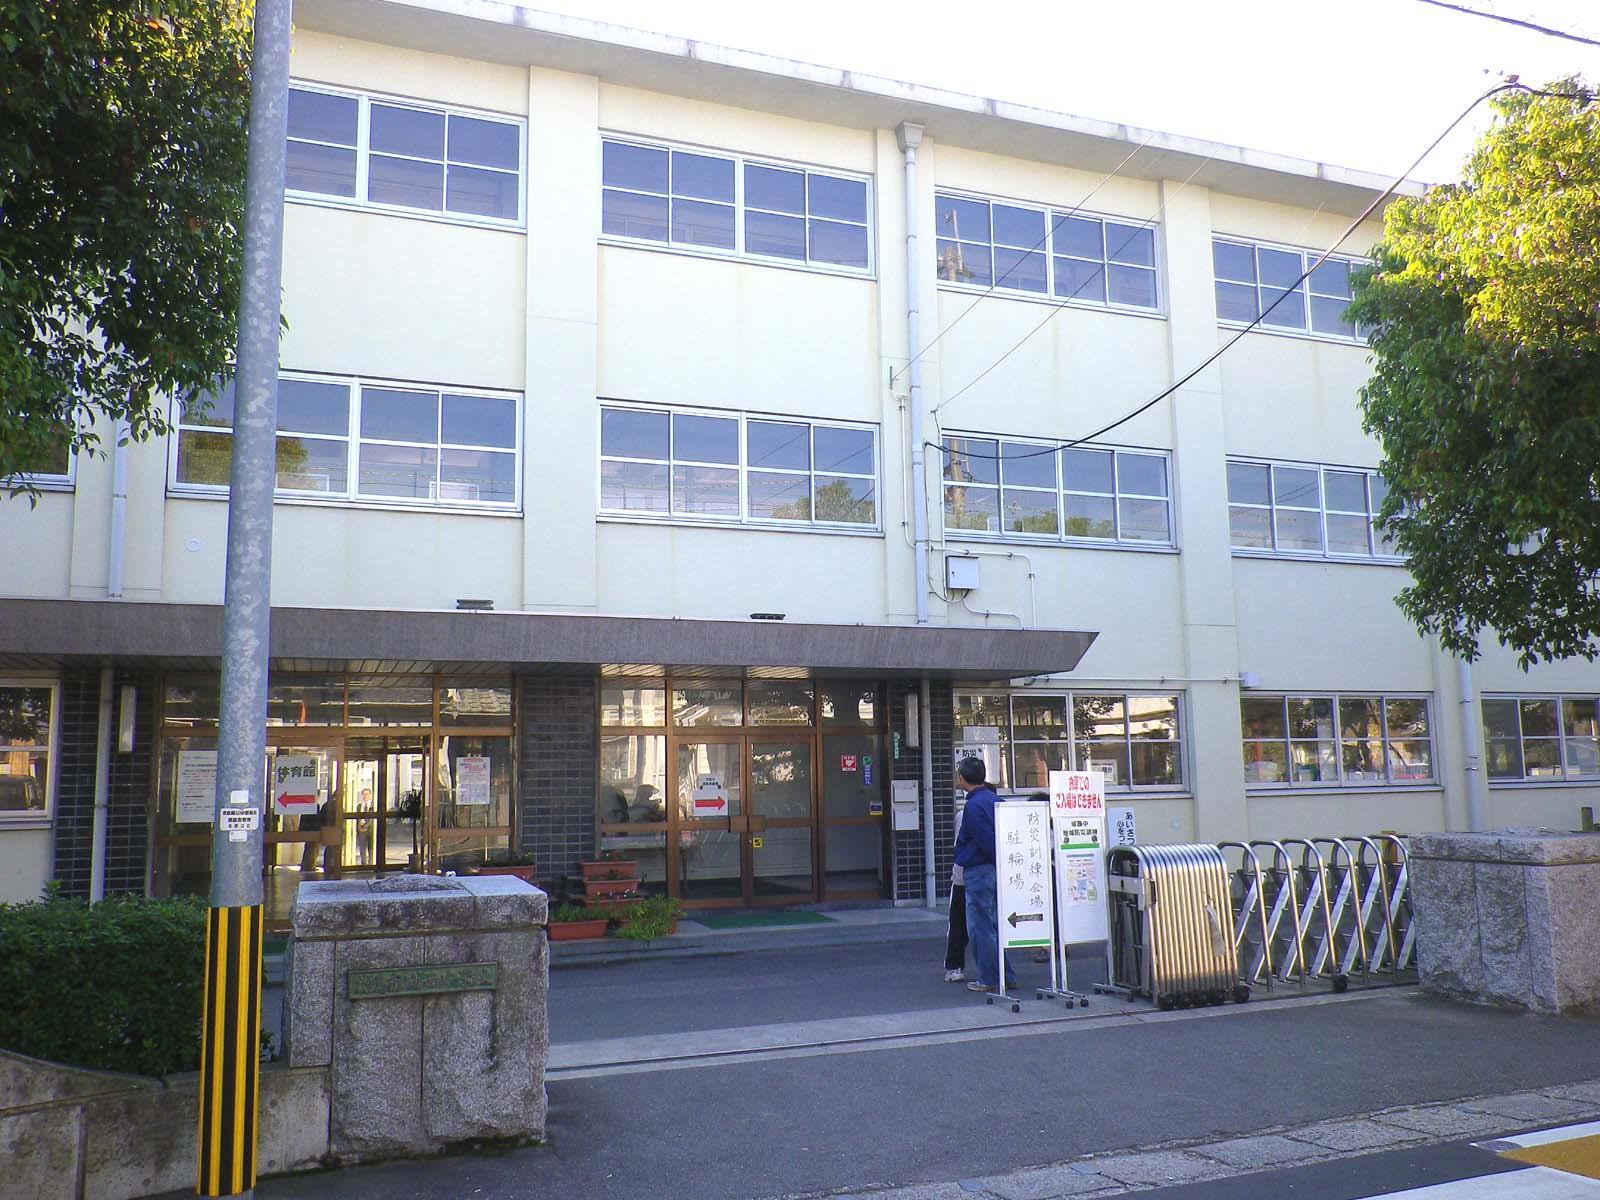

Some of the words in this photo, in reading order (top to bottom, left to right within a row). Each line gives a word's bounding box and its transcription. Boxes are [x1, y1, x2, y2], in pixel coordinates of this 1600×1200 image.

[278, 765, 316, 778] 体育館
[1068, 775, 1090, 791] お車での
[1055, 793, 1102, 809] ご入場はできません
[1117, 821, 1126, 846] 心をつ
[1125, 812, 1136, 845] あいさつ
[1007, 830, 1025, 889] 駐輪場
[1026, 813, 1044, 909] 防災訓練会場
